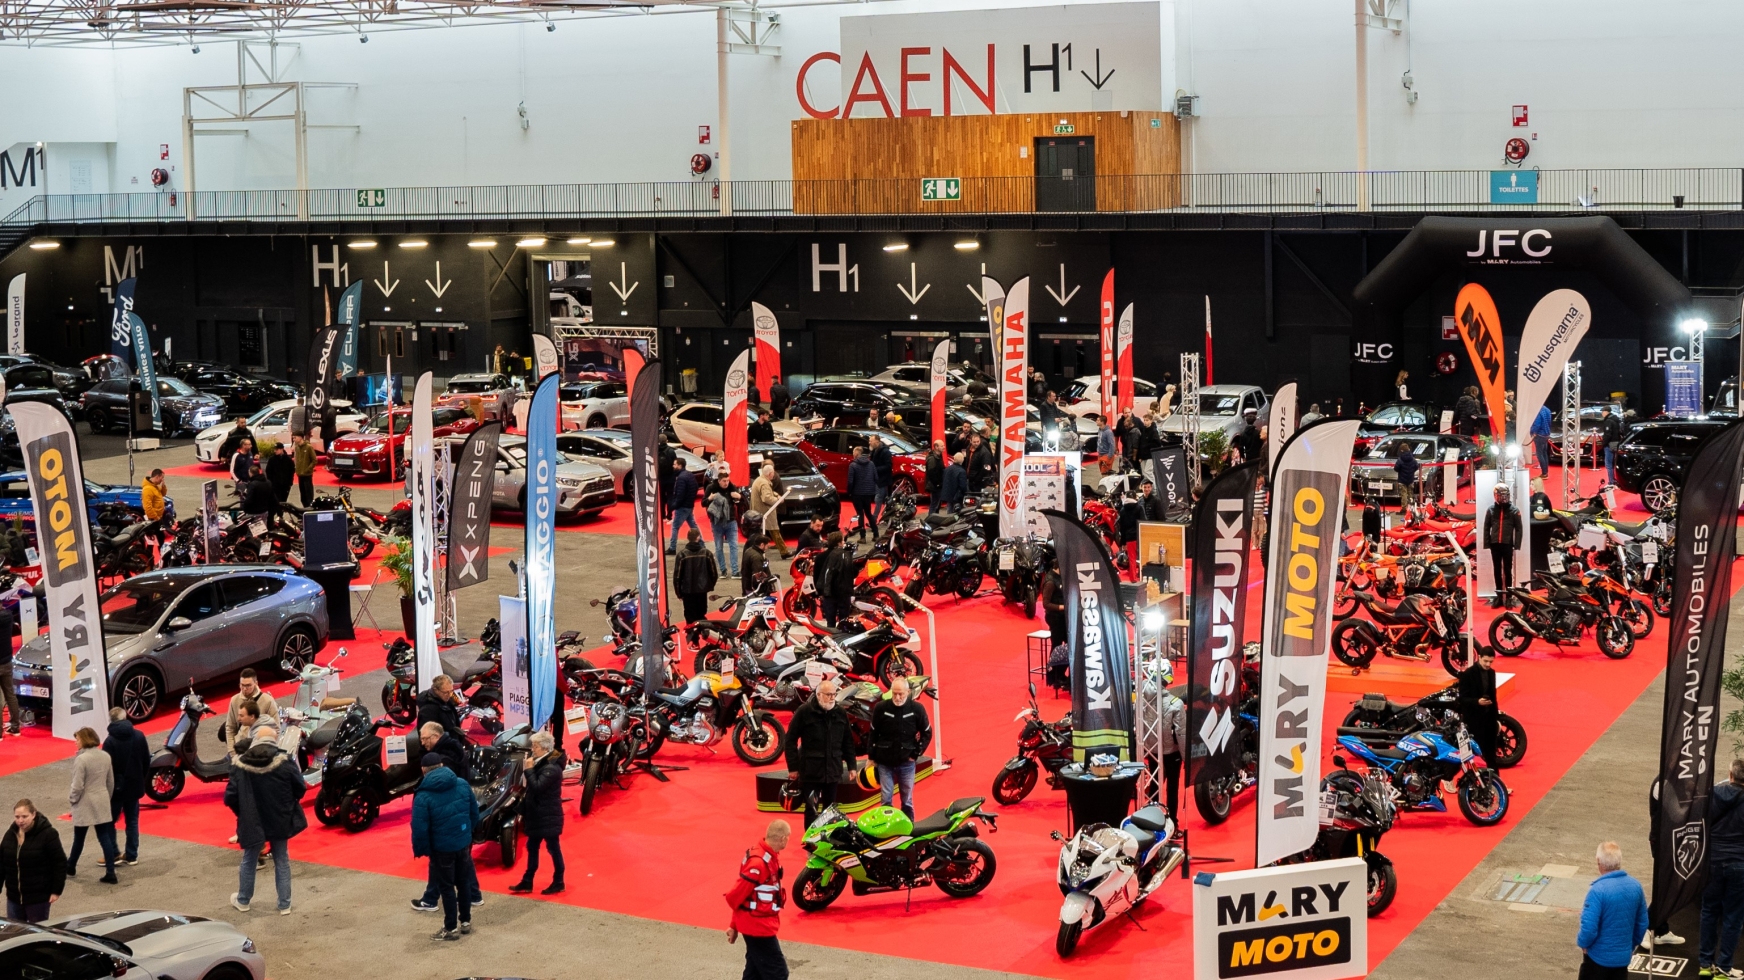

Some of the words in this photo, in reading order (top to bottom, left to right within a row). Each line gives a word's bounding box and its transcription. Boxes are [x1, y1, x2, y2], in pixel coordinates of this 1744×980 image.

[796, 43, 995, 119] CAEN
[1466, 229, 1552, 257] JFC
[111, 295, 134, 346] Ford
[1534, 306, 1579, 369] Husqvarna
[1563, 313, 1585, 344] MOTORCYCLES
[316, 329, 338, 384] LEXUS
[1354, 342, 1393, 359] JFC
[1643, 346, 1686, 363] JFC
[1003, 310, 1025, 469] YAMAHA
[465, 440, 486, 540] XPENG
[1284, 486, 1326, 640] MOTO
[1210, 498, 1244, 696] SUZUKI
[1684, 524, 1709, 703] AUTOMOBILES
[509, 692, 530, 706] PIAGG
[1274, 673, 1310, 820] MARY
[1678, 709, 1695, 780] MARY
[1217, 881, 1350, 926] MARY
[1229, 929, 1340, 968] MOTO
